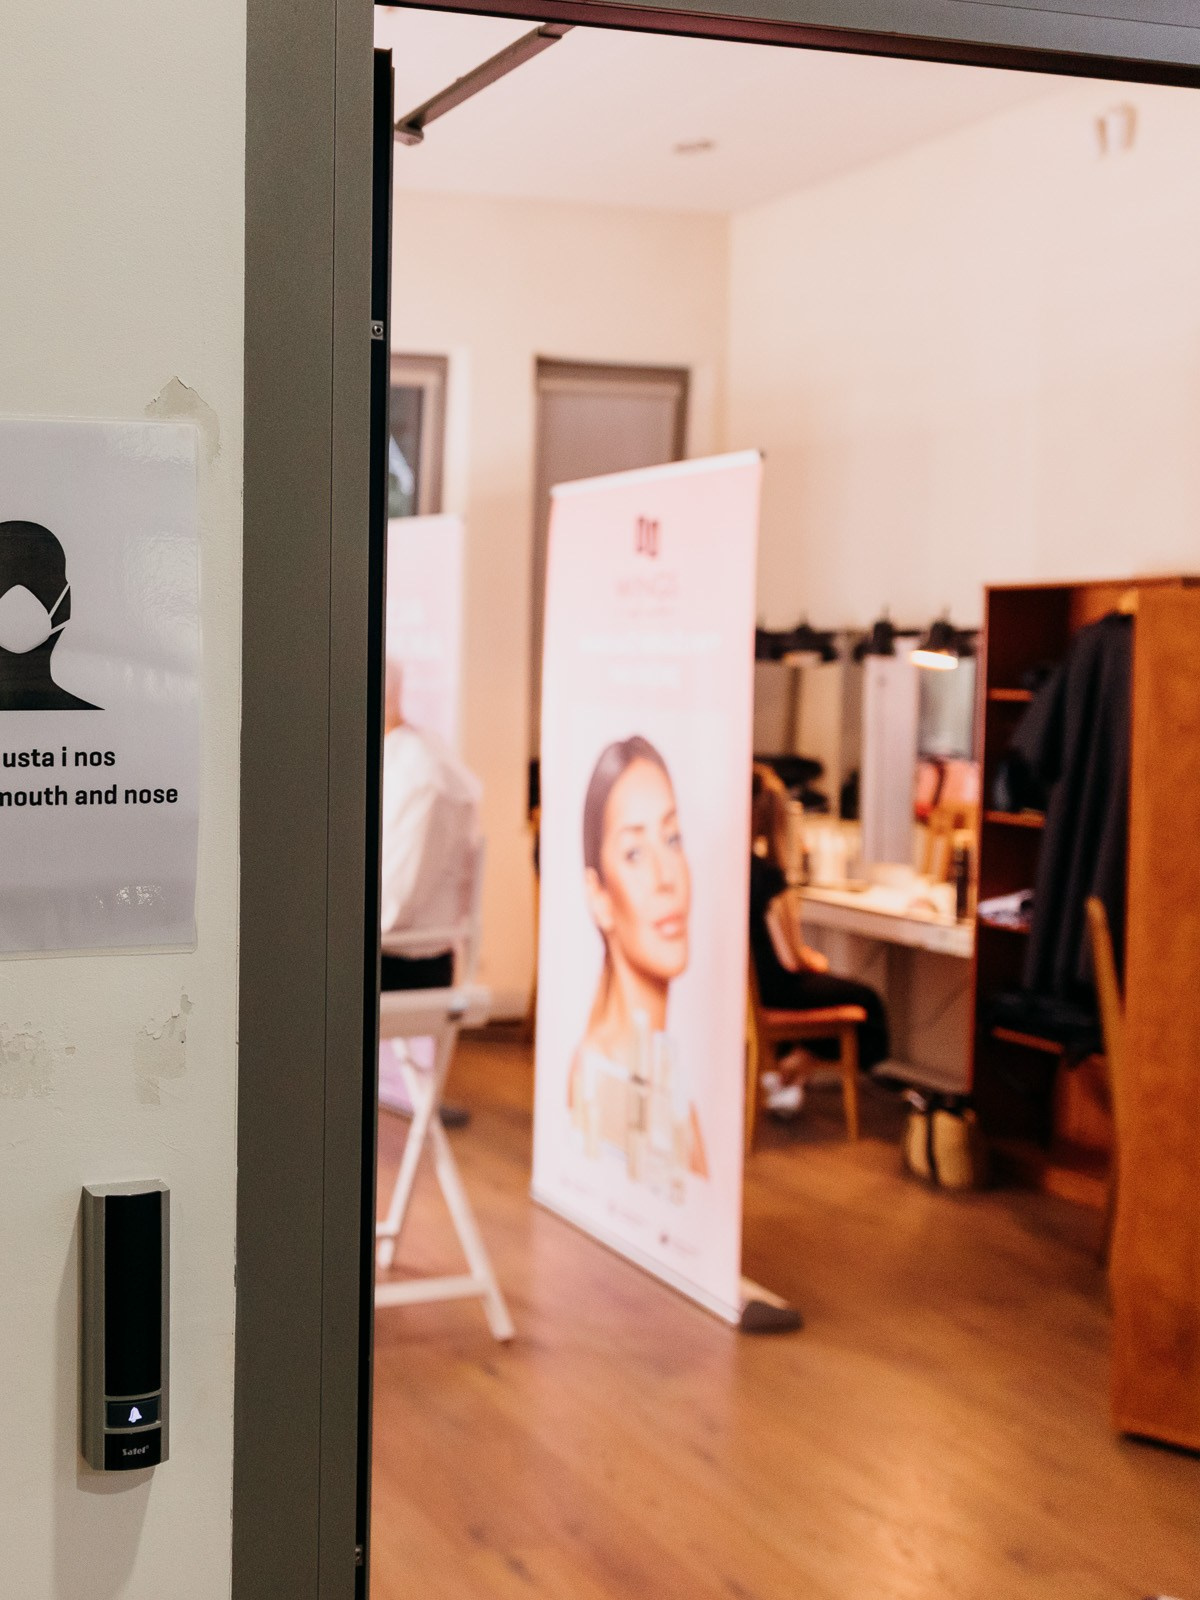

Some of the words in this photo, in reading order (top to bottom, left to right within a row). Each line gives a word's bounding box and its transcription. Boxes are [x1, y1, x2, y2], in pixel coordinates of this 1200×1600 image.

[2, 748, 55, 769] usta
[61, 746, 67, 767] i
[74, 750, 116, 767] nos
[74, 784, 118, 806] and
[124, 788, 179, 805] nose
